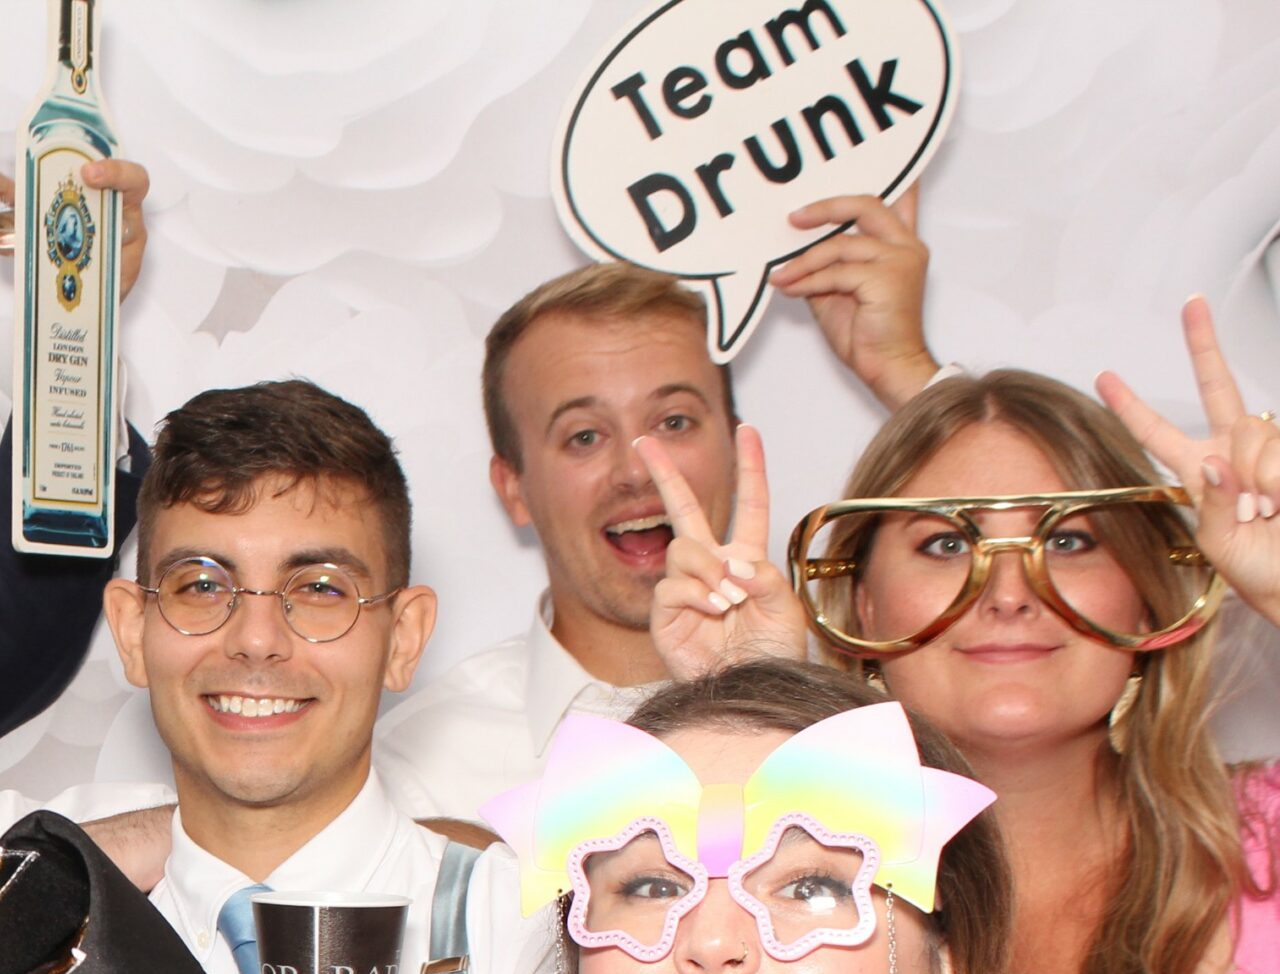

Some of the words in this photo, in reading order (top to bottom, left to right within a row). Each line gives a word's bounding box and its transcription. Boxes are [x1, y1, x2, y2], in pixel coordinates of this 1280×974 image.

[610, 0, 847, 141] Team
[627, 58, 923, 253] Drunk
[49, 322, 89, 343] Distilled
[53, 343, 85, 353] LONDON
[48, 352, 69, 365] DRY
[69, 354, 89, 368] GIN
[49, 385, 87, 398] INFUSED
